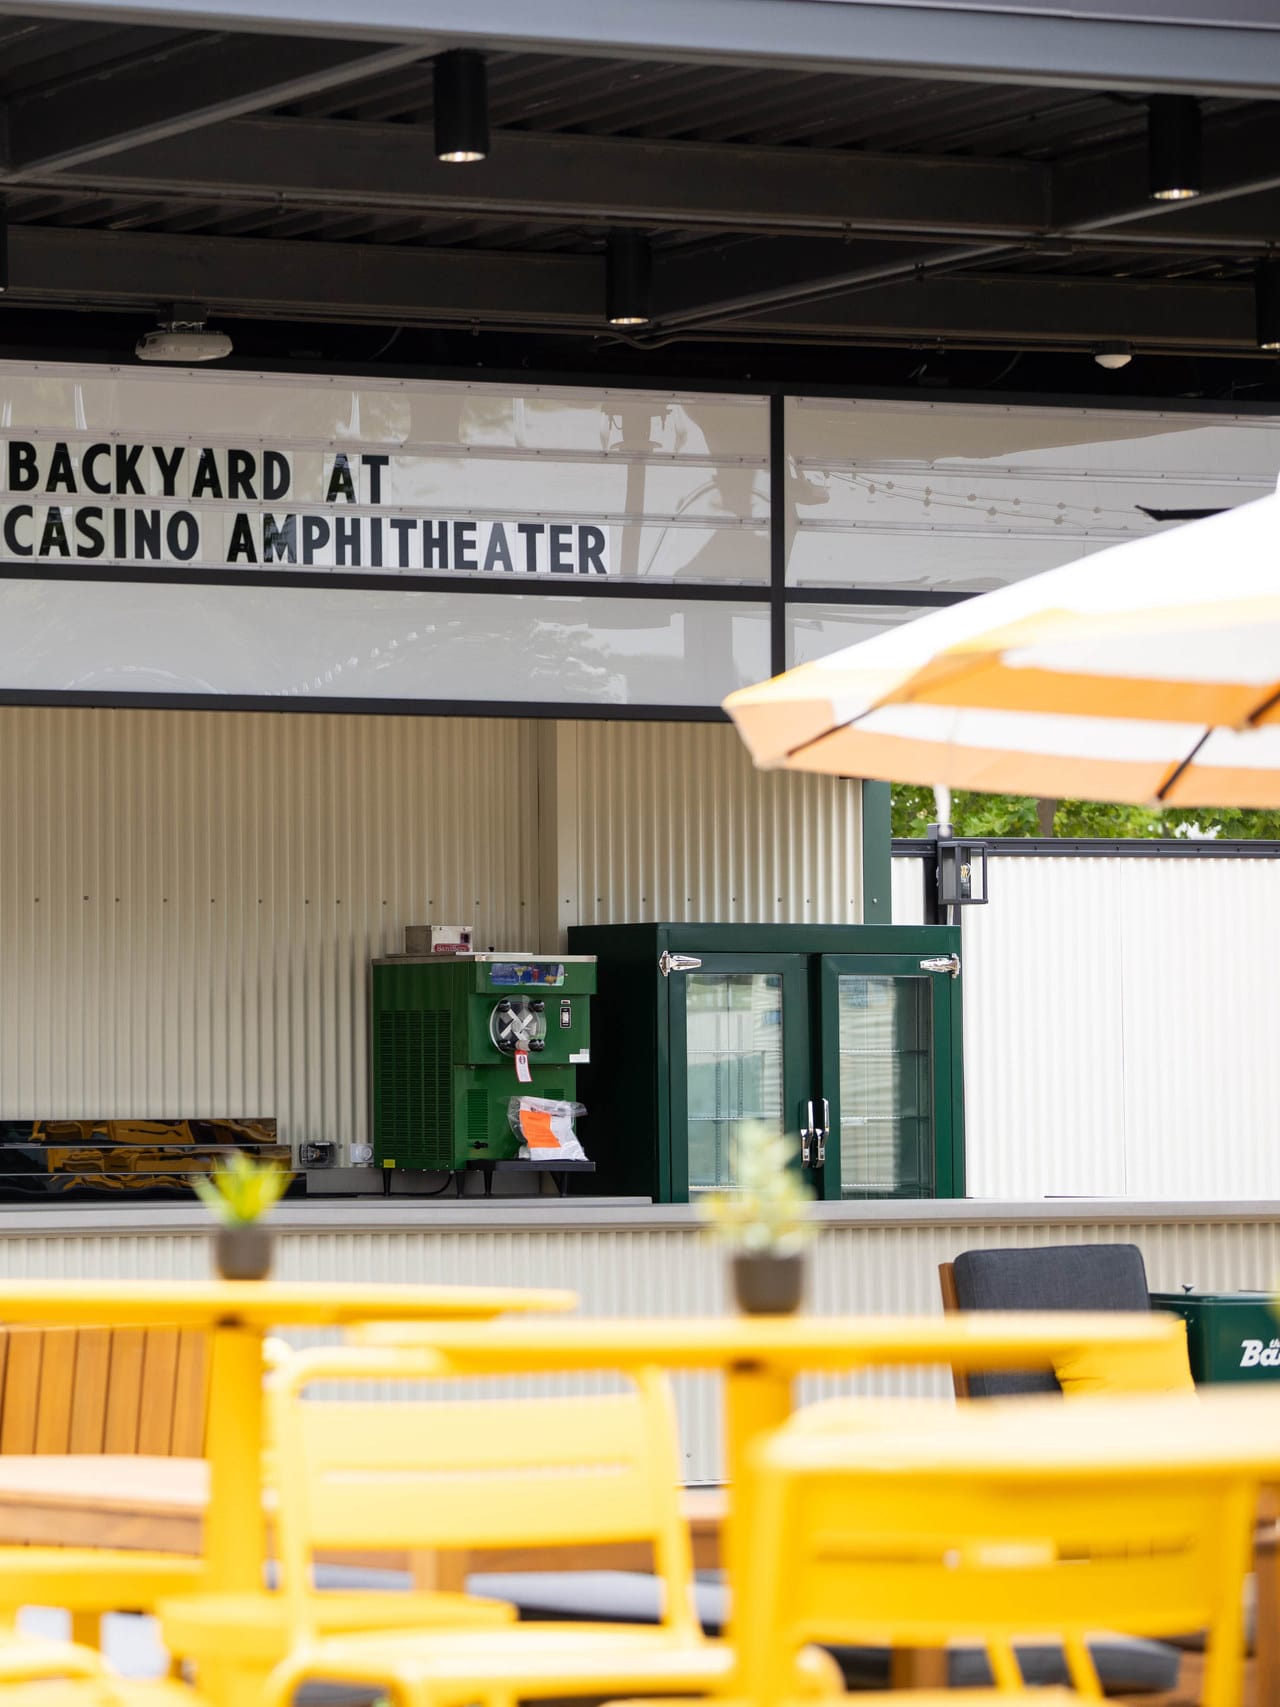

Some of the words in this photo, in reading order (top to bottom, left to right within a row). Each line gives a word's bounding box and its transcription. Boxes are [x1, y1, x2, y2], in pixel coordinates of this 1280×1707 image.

[8, 440, 291, 501] BACKYARD
[326, 453, 389, 504] AT
[3, 504, 199, 561] CASINO
[226, 512, 607, 574] AMPHITHEATER
[1239, 1339, 1280, 1367] Ba
